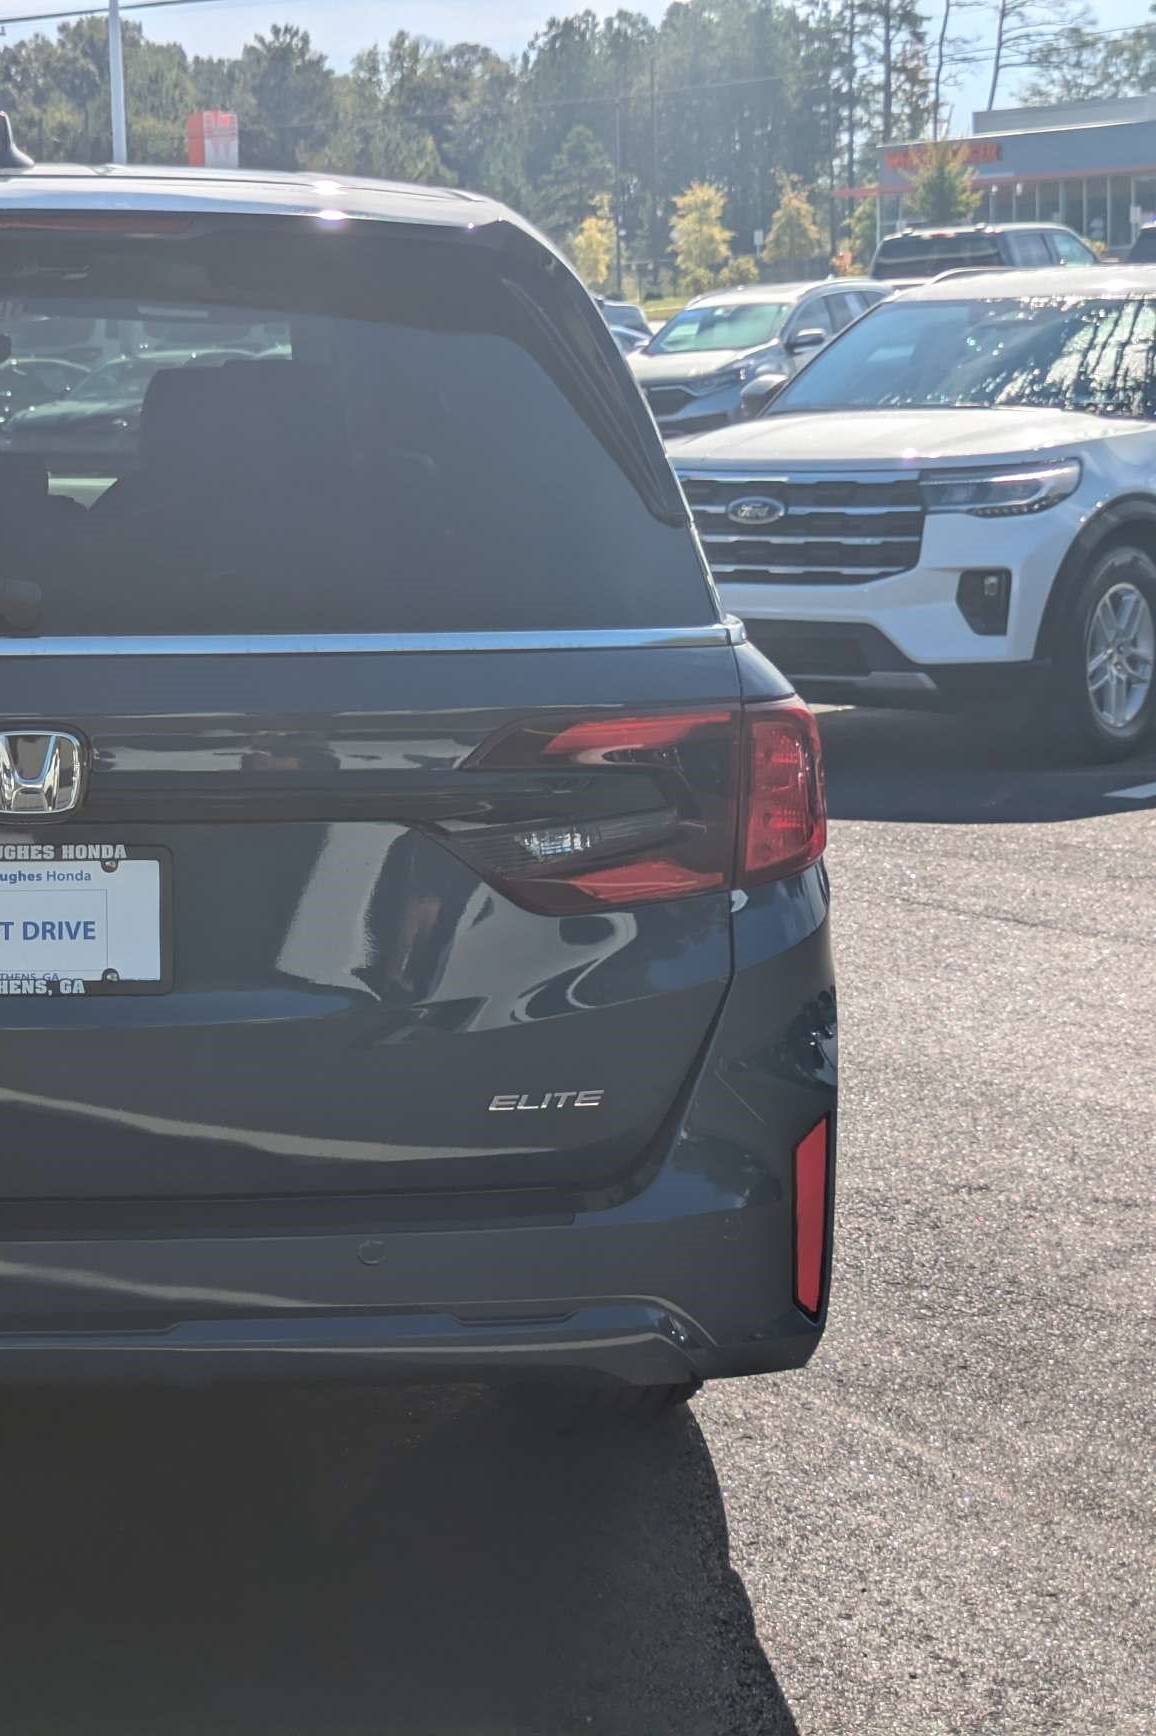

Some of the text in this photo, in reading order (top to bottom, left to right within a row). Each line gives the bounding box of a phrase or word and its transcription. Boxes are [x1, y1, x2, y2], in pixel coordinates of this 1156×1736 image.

[61, 844, 127, 859] HONDA
[46, 871, 92, 881] Honda
[22, 920, 96, 940] DRIVE
[59, 979, 85, 994] GA
[488, 1089, 604, 1111] ELITE
